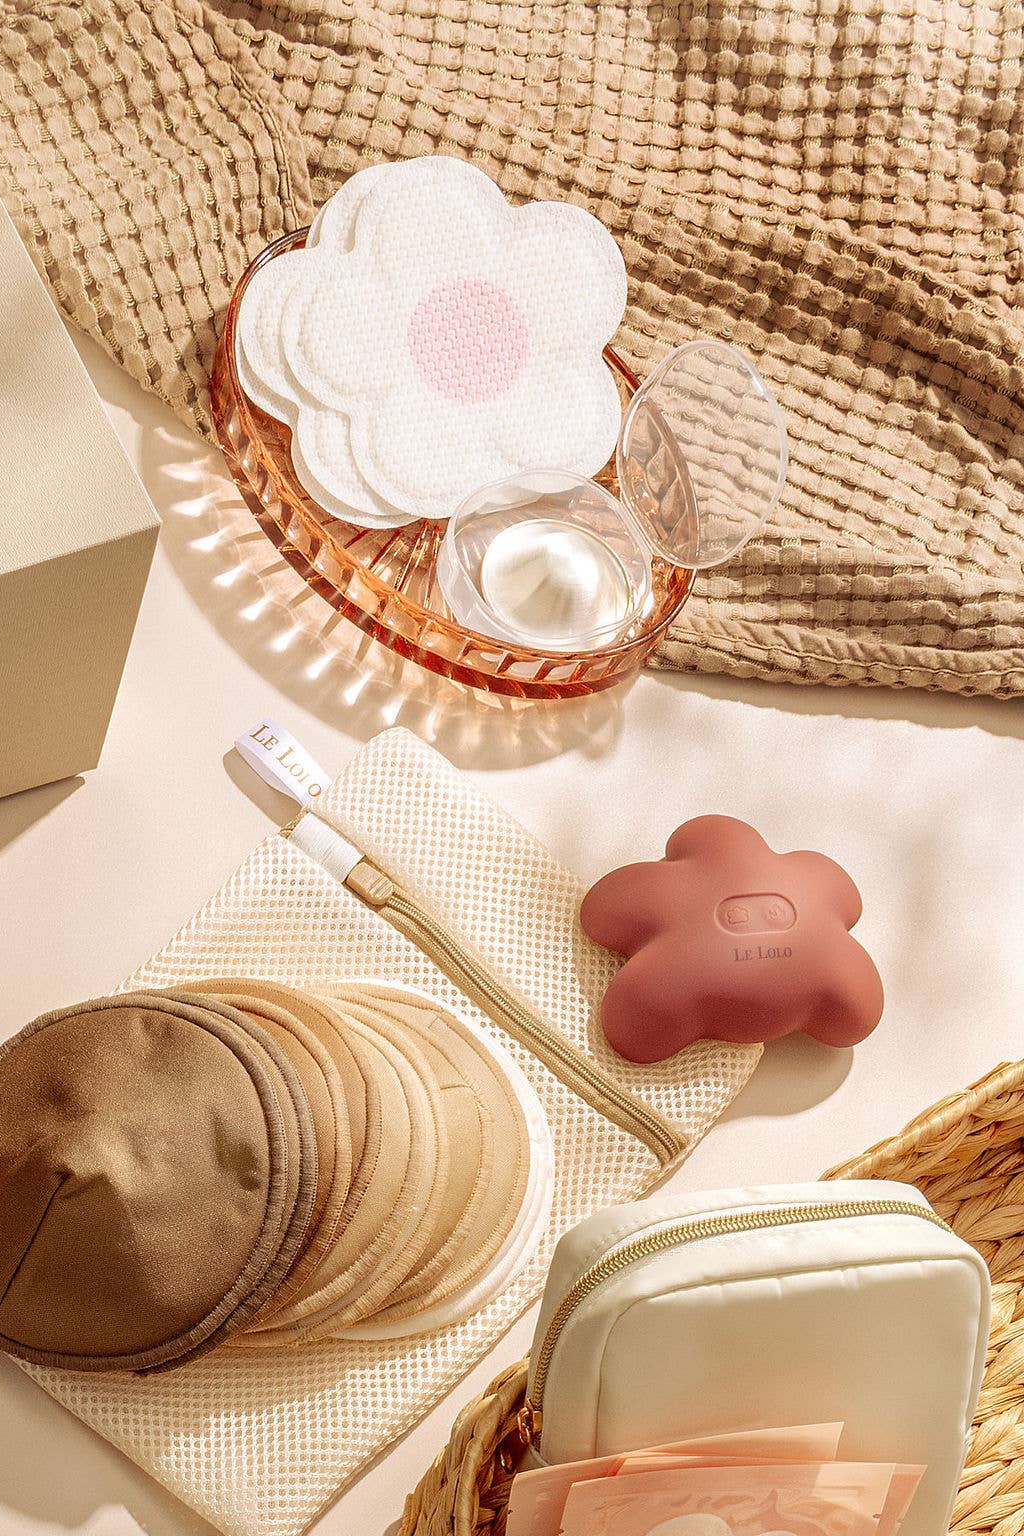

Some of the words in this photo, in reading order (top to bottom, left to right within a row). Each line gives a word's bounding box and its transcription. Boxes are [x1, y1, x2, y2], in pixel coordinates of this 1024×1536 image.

[250, 724, 279, 751] LE
[733, 947, 753, 962] LE
[758, 945, 793, 960] LOLO
